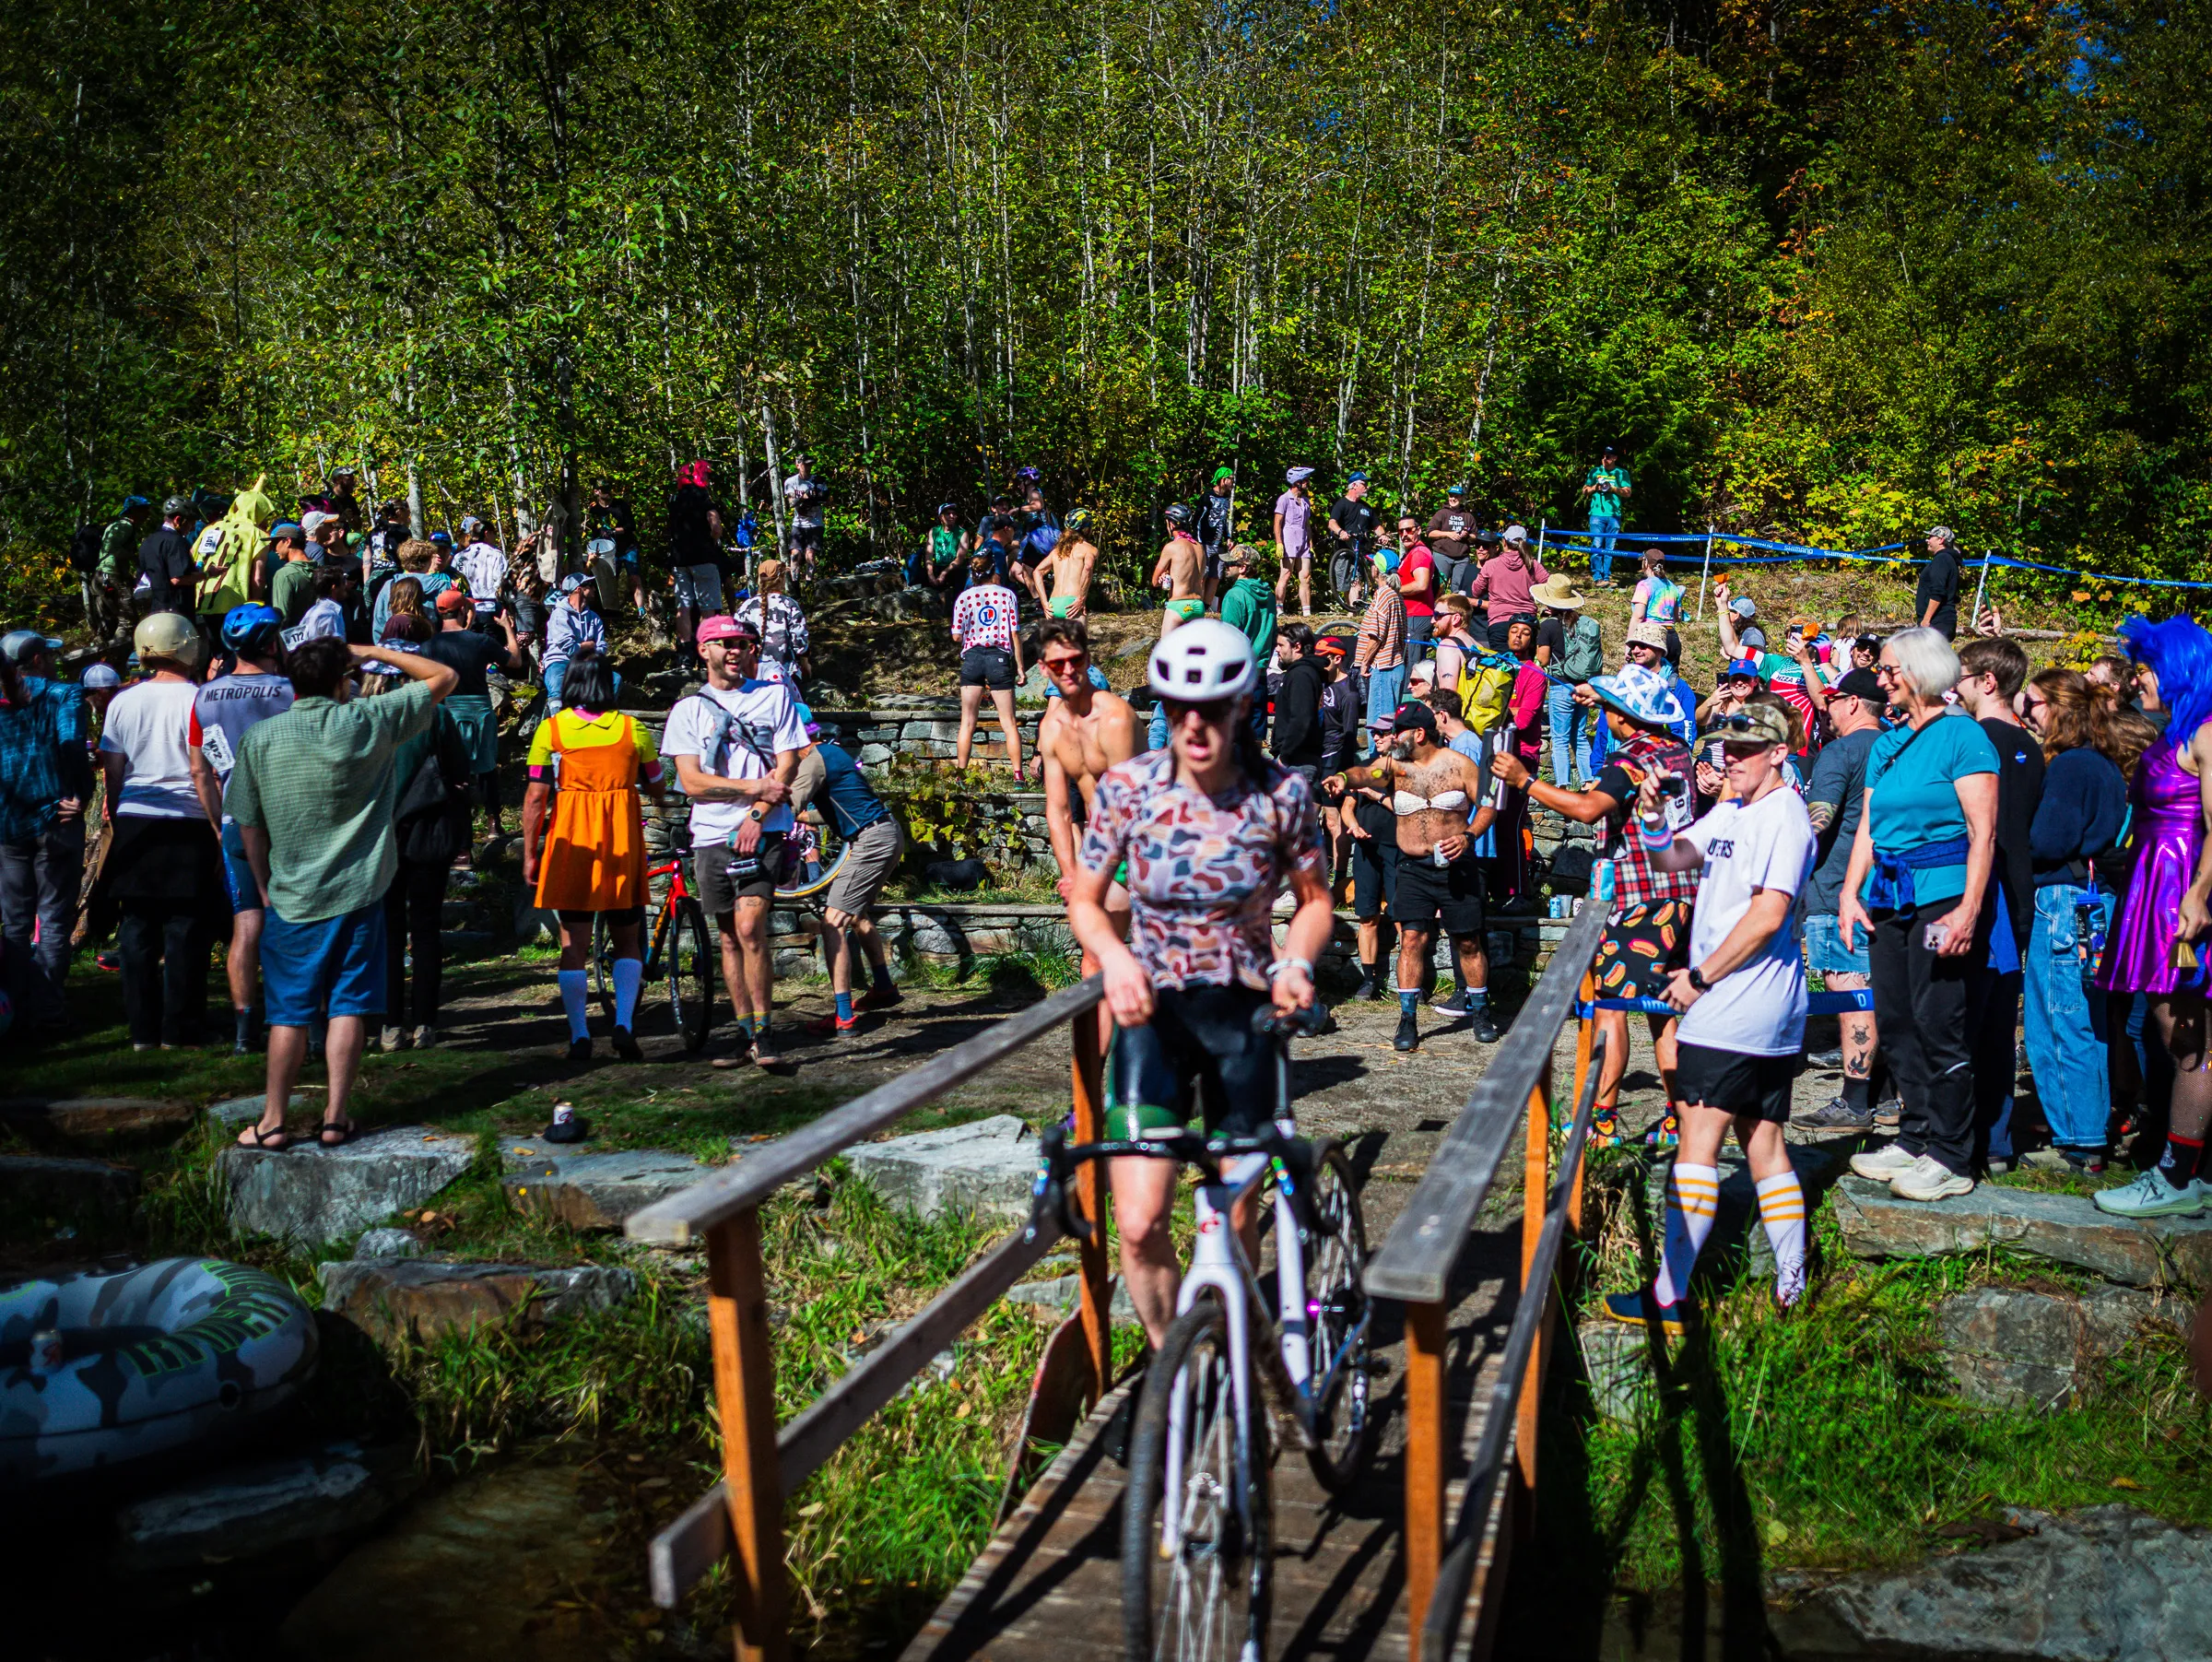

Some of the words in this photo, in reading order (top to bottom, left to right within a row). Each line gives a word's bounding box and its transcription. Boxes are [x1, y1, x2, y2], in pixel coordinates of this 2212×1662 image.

[1784, 545, 1814, 555] SHIMANO
[1824, 550, 1853, 560] SHIMANO
[291, 631, 305, 643] 172
[204, 686, 283, 702] METROPOLIS
